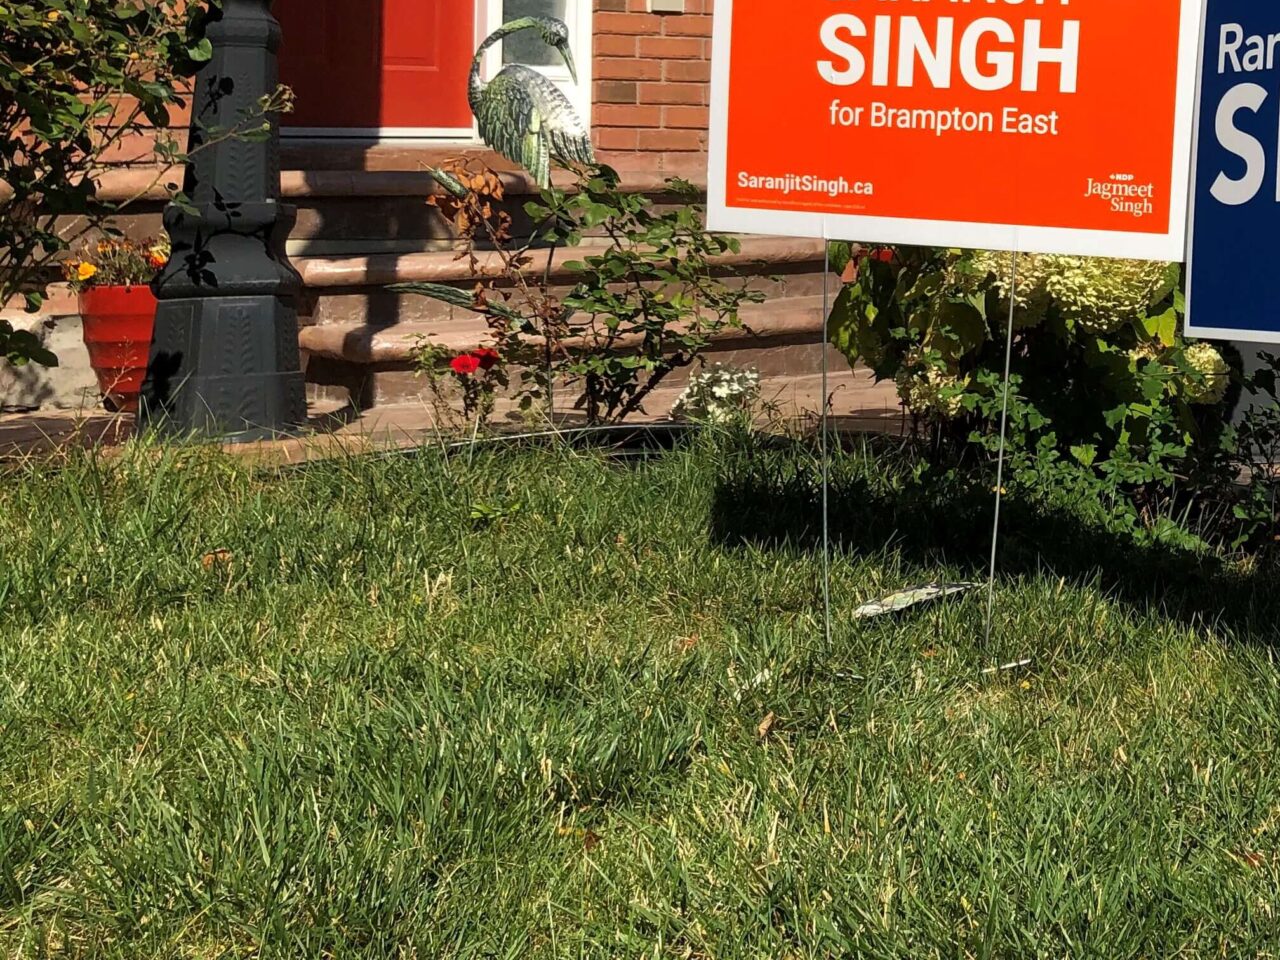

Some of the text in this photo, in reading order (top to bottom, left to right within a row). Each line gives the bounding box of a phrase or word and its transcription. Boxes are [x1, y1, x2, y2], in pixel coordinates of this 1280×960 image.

[816, 13, 1081, 94] SINGH
[829, 100, 1059, 137] for Brampton East
[737, 171, 873, 197] SaranjitSingh.ca
[1084, 178, 1154, 199] Jagmeet
[1115, 173, 1134, 181] NDP
[1110, 196, 1153, 217] Singh
